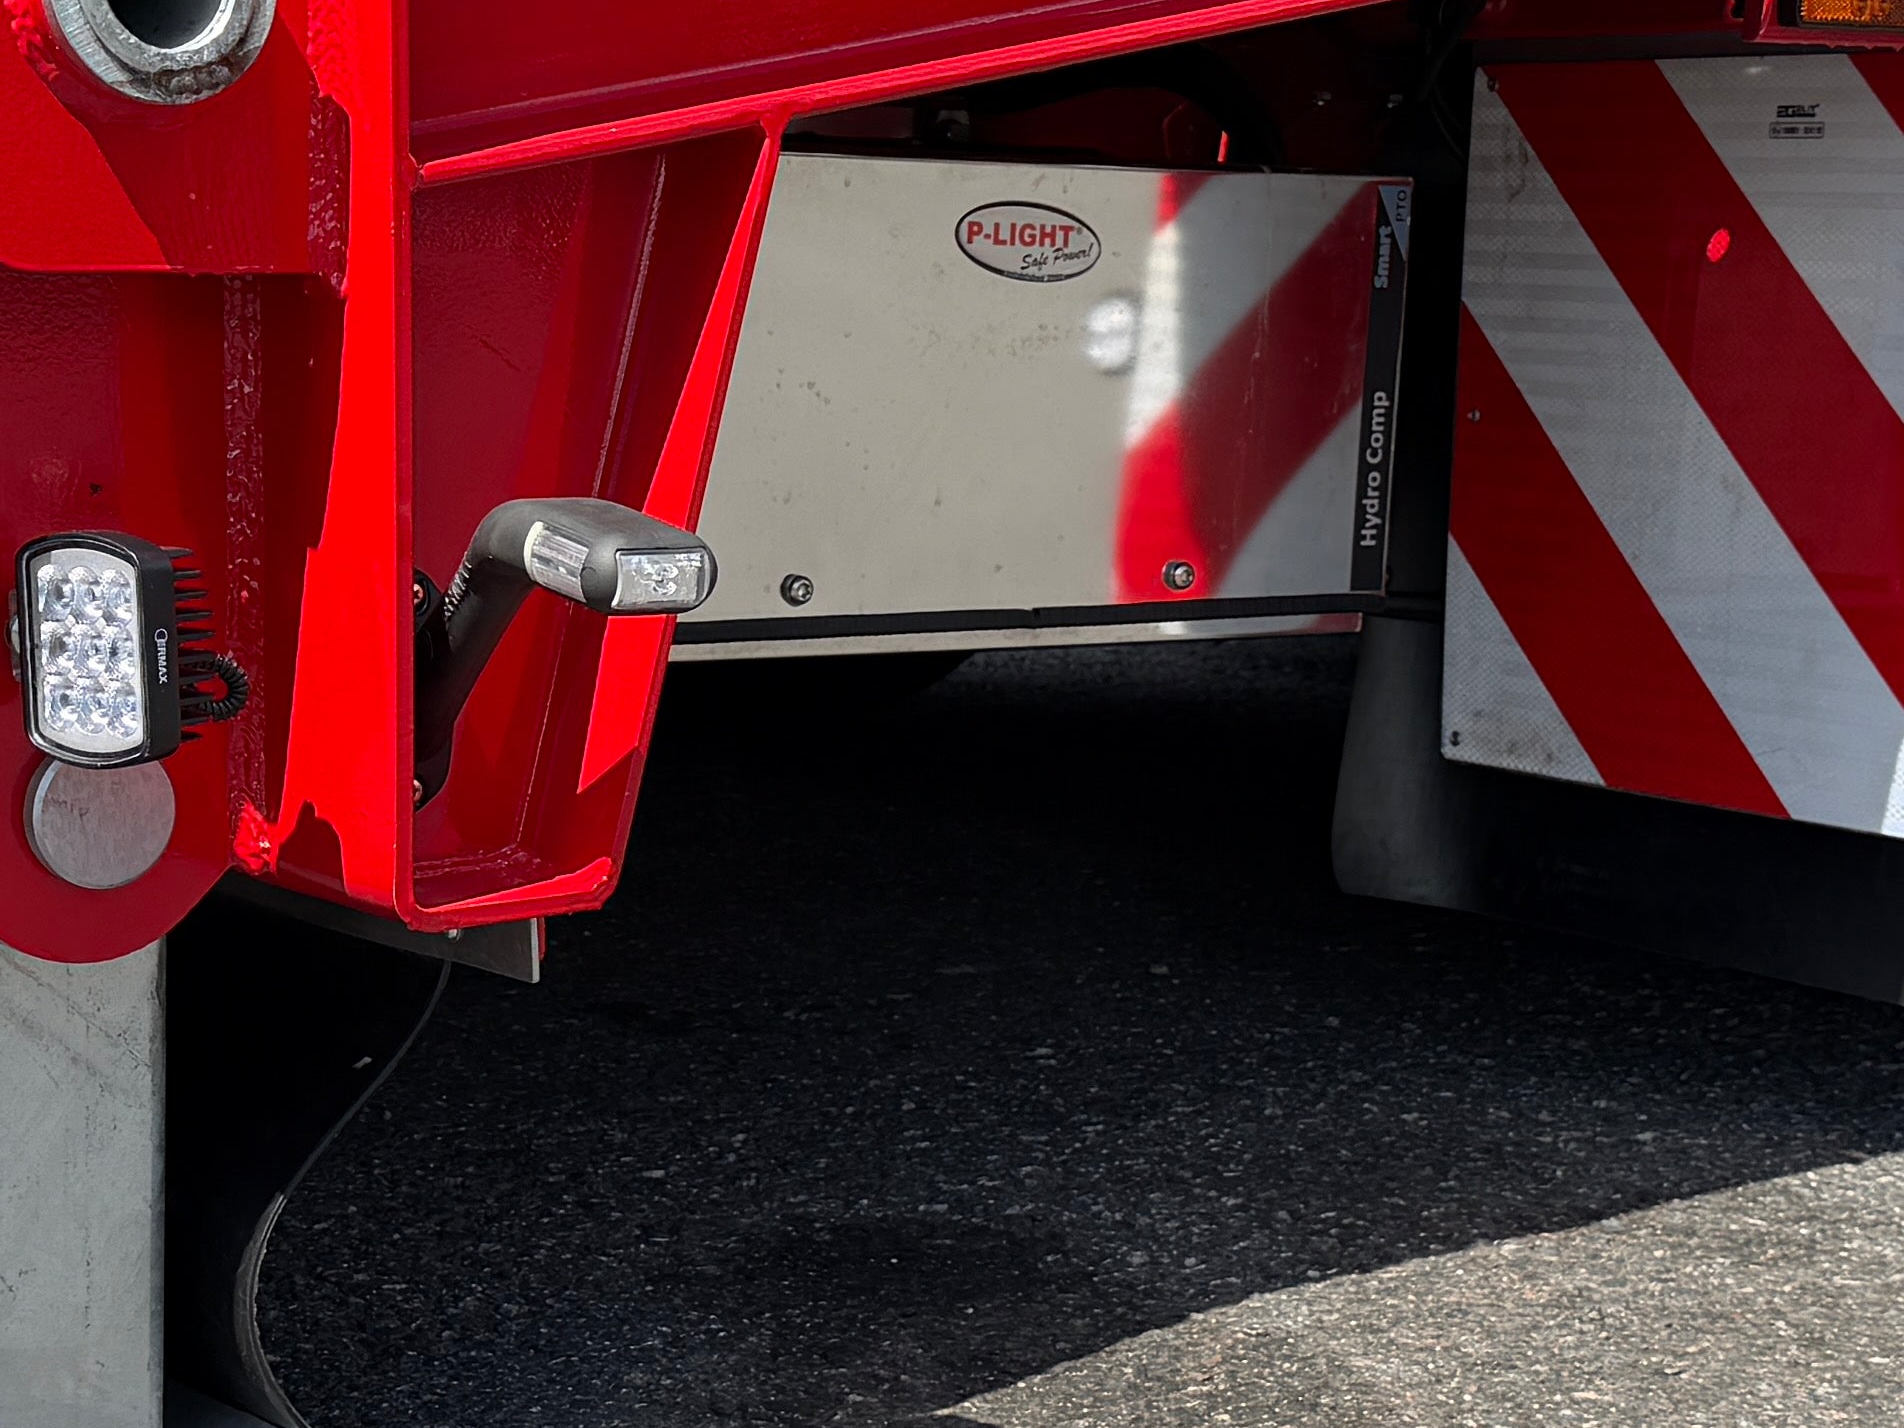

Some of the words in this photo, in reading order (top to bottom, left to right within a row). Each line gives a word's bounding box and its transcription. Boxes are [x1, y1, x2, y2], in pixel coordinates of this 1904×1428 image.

[1396, 189, 1407, 222] PTO
[1020, 252, 1049, 271] Safe
[1374, 224, 1393, 289] Smart
[1366, 390, 1390, 464] Comp
[1360, 471, 1382, 547] Hydro
